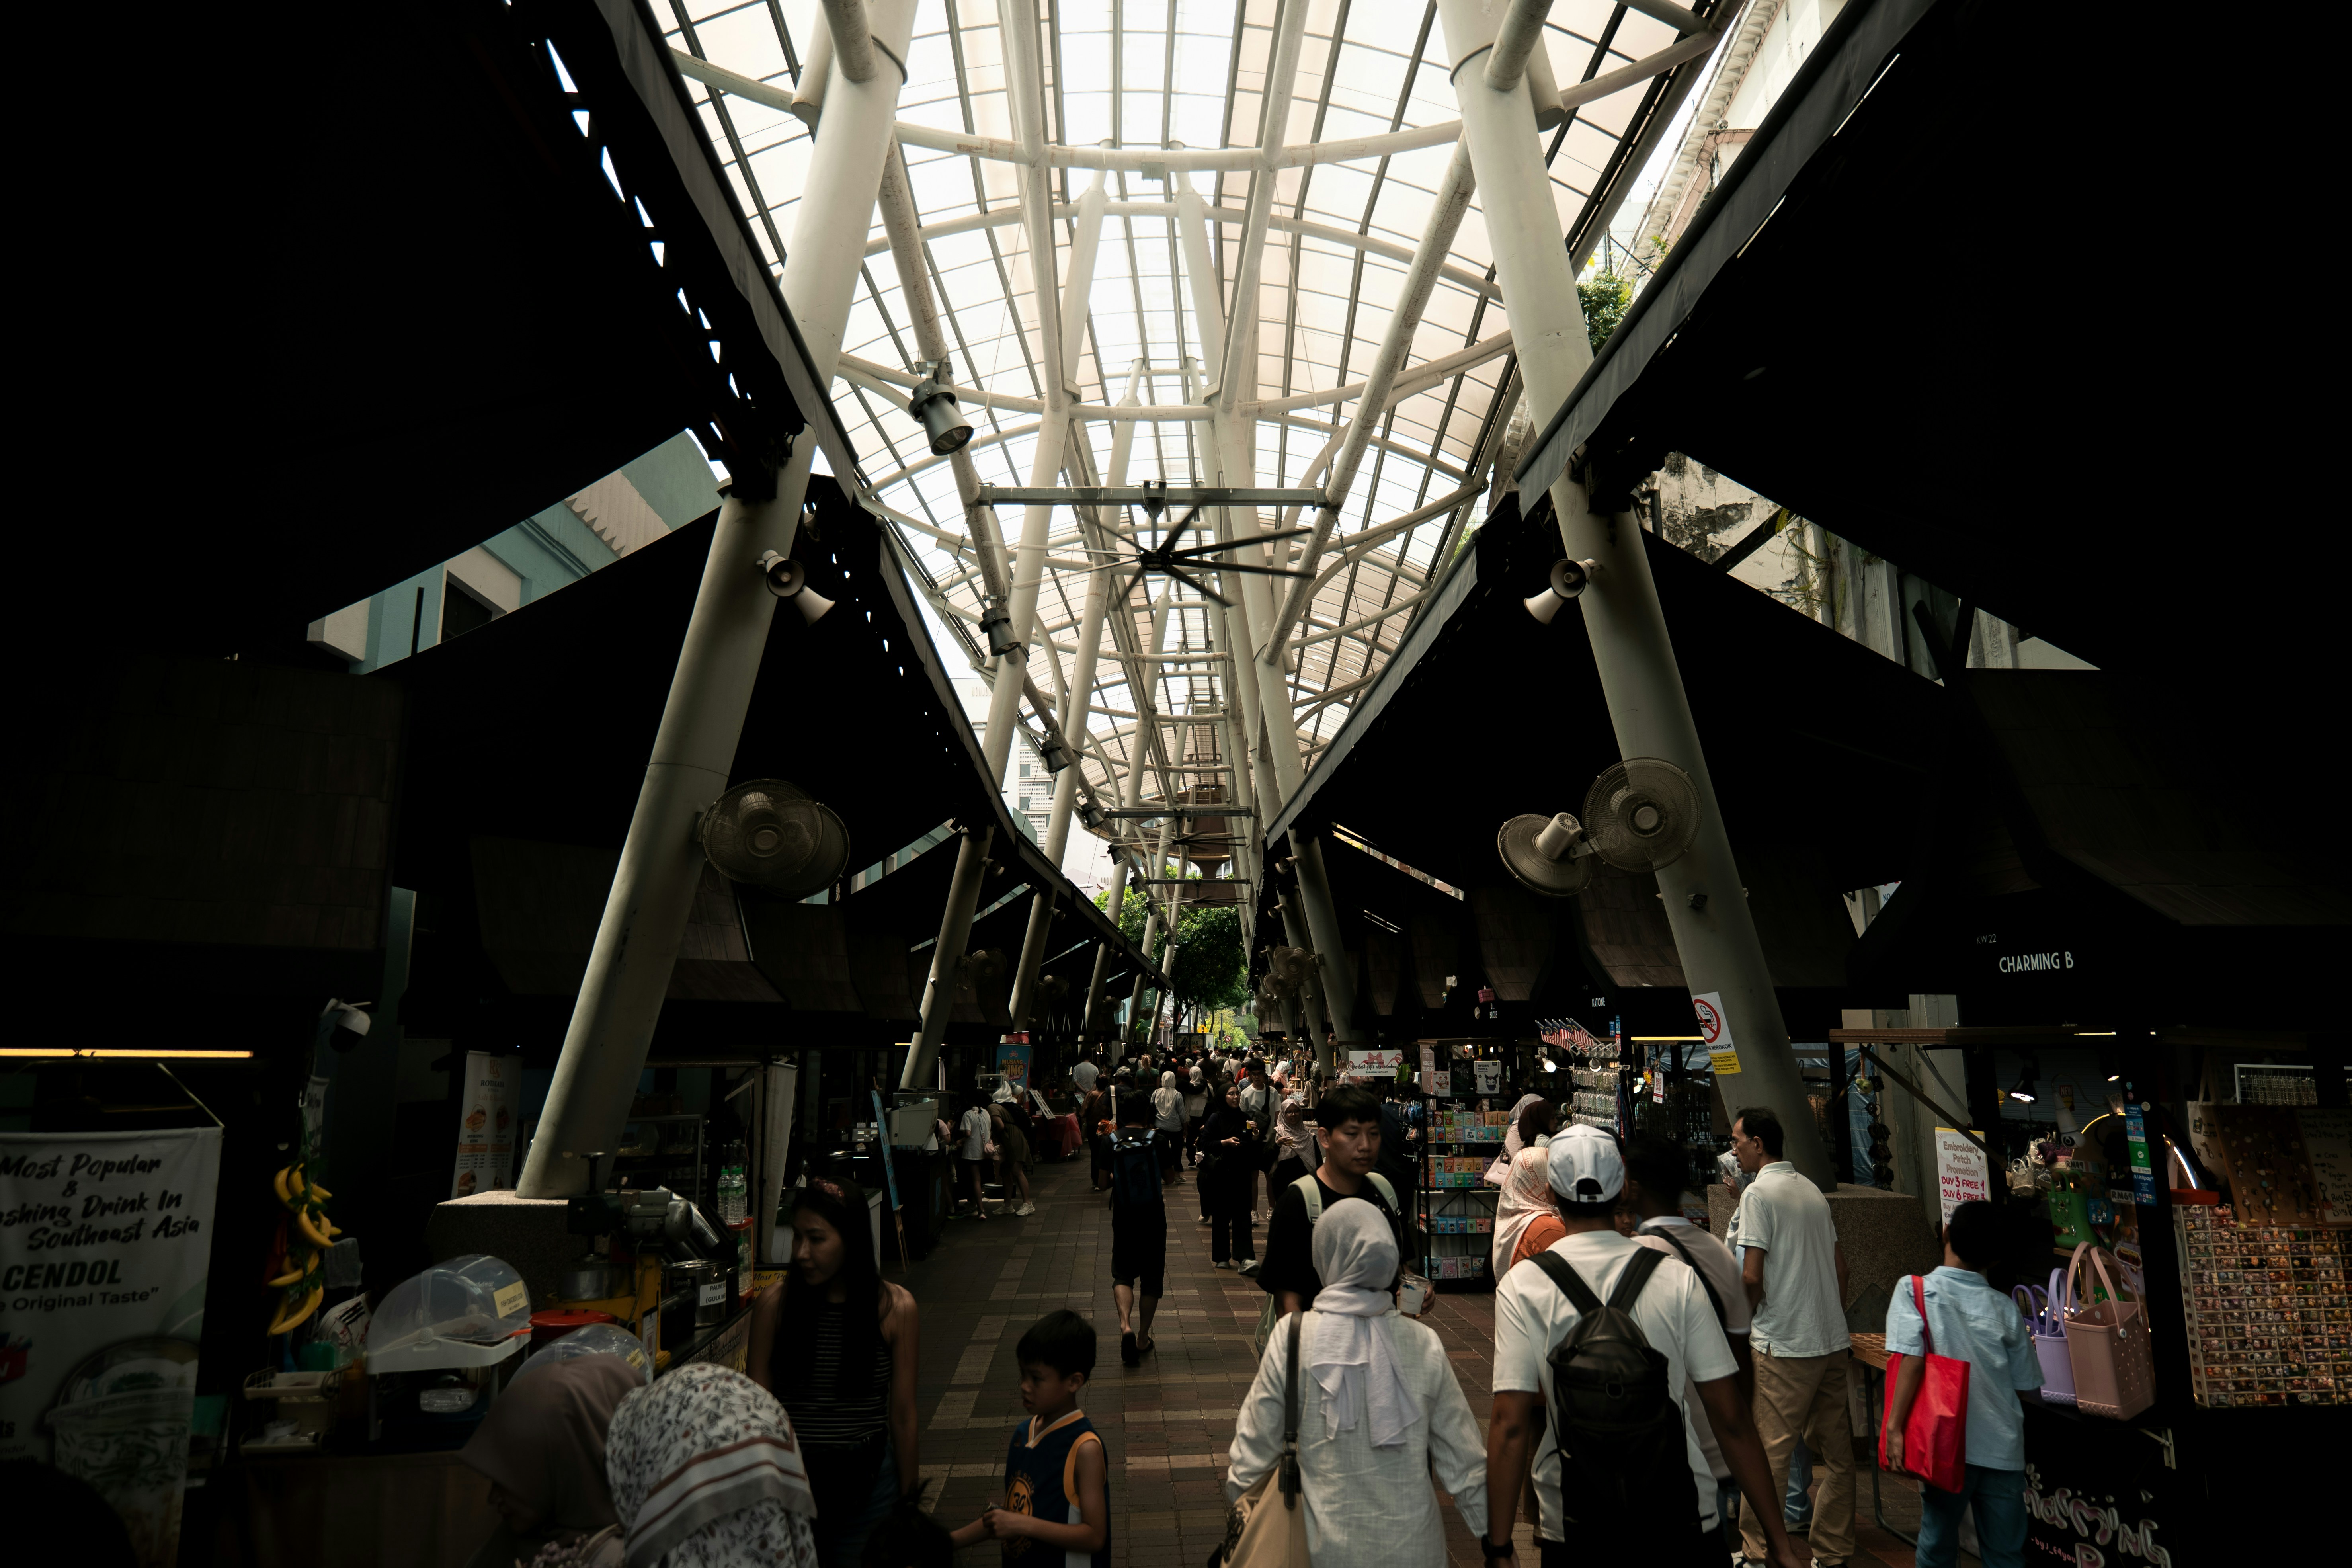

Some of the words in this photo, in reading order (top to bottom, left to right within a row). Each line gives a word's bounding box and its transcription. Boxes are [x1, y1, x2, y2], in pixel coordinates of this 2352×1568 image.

[1977, 935, 1987, 945] KW
[1988, 934, 1997, 943] 22
[1999, 952, 2060, 973] CHARMING
[2065, 951, 2073, 969] B
[1592, 997, 1606, 1008] KATONE
[1005, 1065, 1024, 1075] ING
[2060, 1086, 2073, 1095] NEW
[1943, 1141, 1979, 1154] Embroidery
[1953, 1153, 1971, 1165] Patch
[2066, 1160, 2084, 1170] RM49
[0, 1155, 66, 1179] Most
[69, 1153, 162, 1182] Popular
[1946, 1164, 1979, 1177] Promotion
[62, 1181, 79, 1197] &
[1941, 1176, 1954, 1185] BUY
[1955, 1176, 1961, 1188] 3
[1962, 1179, 1979, 1189] FREE
[1980, 1179, 1985, 1191] 1
[1942, 1189, 1955, 1198] BUY
[1956, 1189, 1962, 1201] 6
[1963, 1192, 1979, 1201] FREE
[2112, 1191, 2133, 1201] RM69
[2331, 1193, 2344, 1204] Buy
[2343, 1191, 2352, 1201] 5
[82, 1192, 151, 1219] Drink
[158, 1190, 183, 1211] In
[27, 1218, 147, 1250] Southeast
[153, 1215, 201, 1238] Asia
[2, 1259, 122, 1291] CENDOL
[12, 1293, 94, 1312] Original
[706, 1295, 721, 1304] (GULA
[1013, 1492, 1026, 1511] 30
